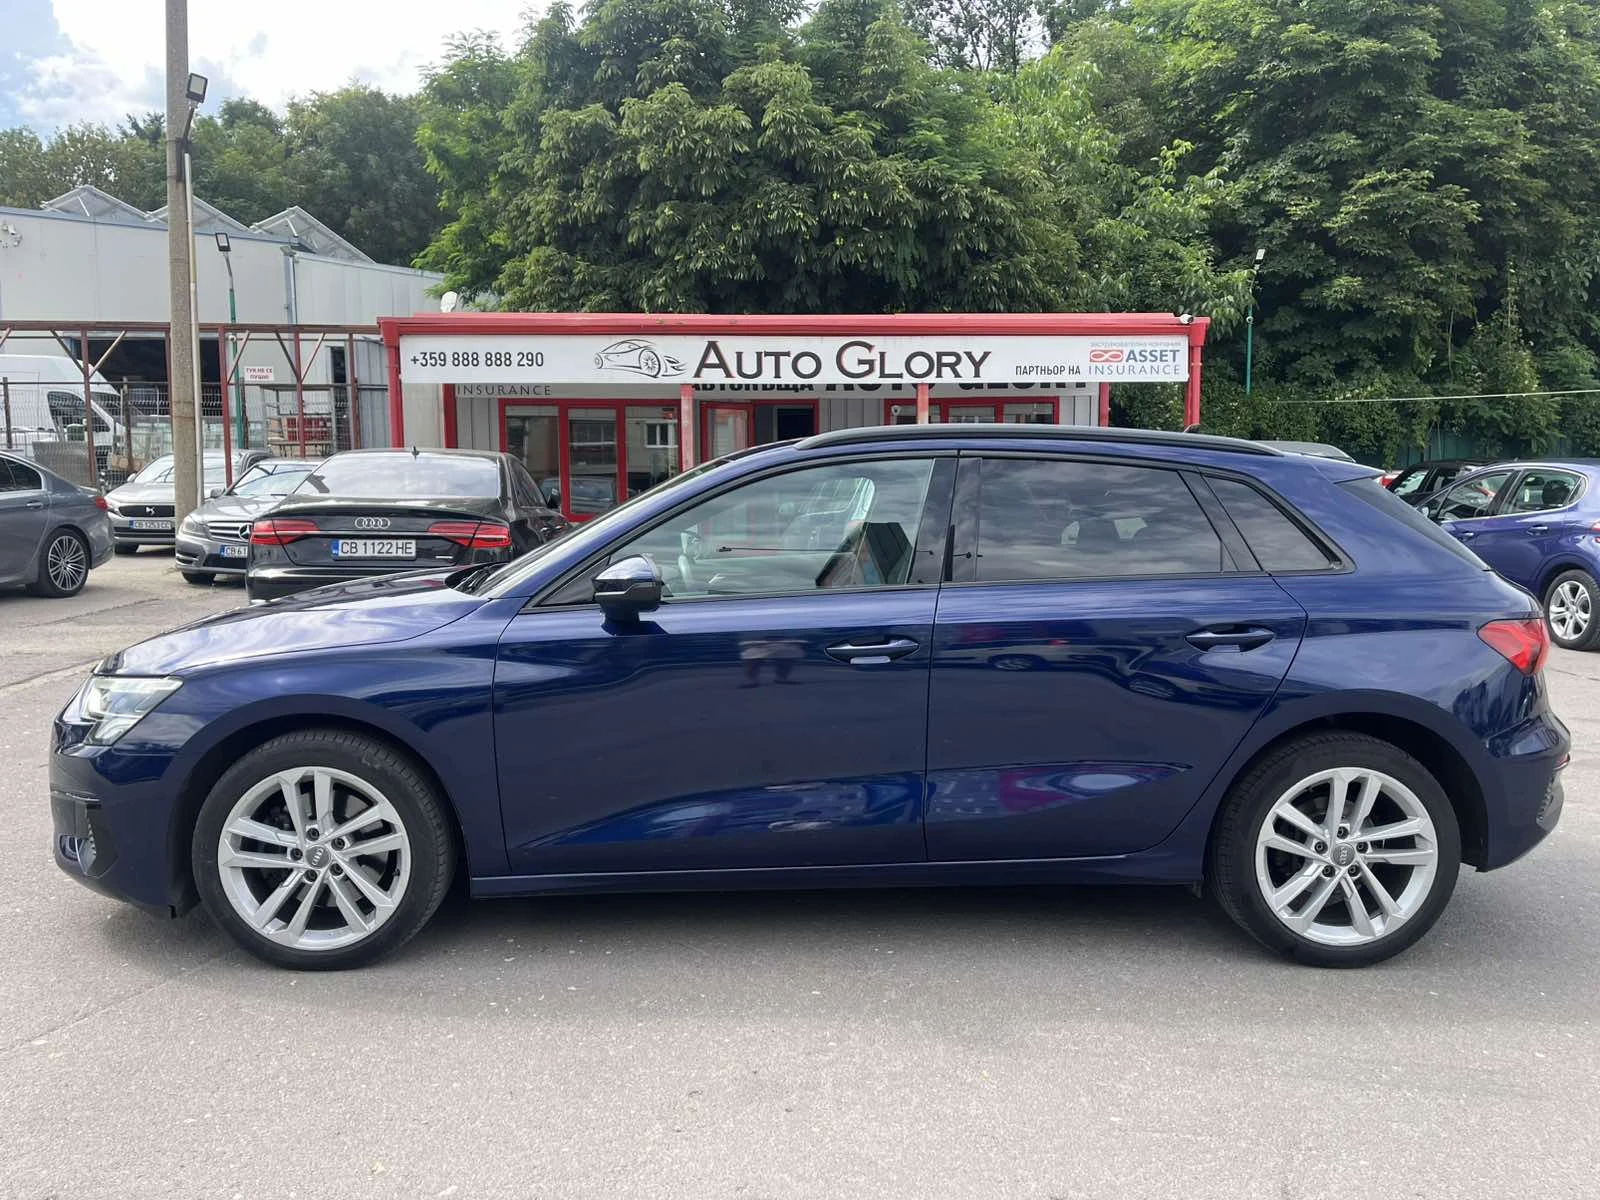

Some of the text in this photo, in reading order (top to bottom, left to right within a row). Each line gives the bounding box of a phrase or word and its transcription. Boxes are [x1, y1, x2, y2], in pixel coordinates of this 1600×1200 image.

[410, 352, 544, 367] +359 888 888 290
[693, 340, 992, 379] AUTO GLORY
[1125, 349, 1181, 362] ASSET
[1015, 365, 1081, 376] ПАРТНЬОР НА
[1088, 364, 1181, 375] INSURANCE
[457, 384, 552, 396] INSURANCE
[341, 542, 413, 554] CB 1122 HE
